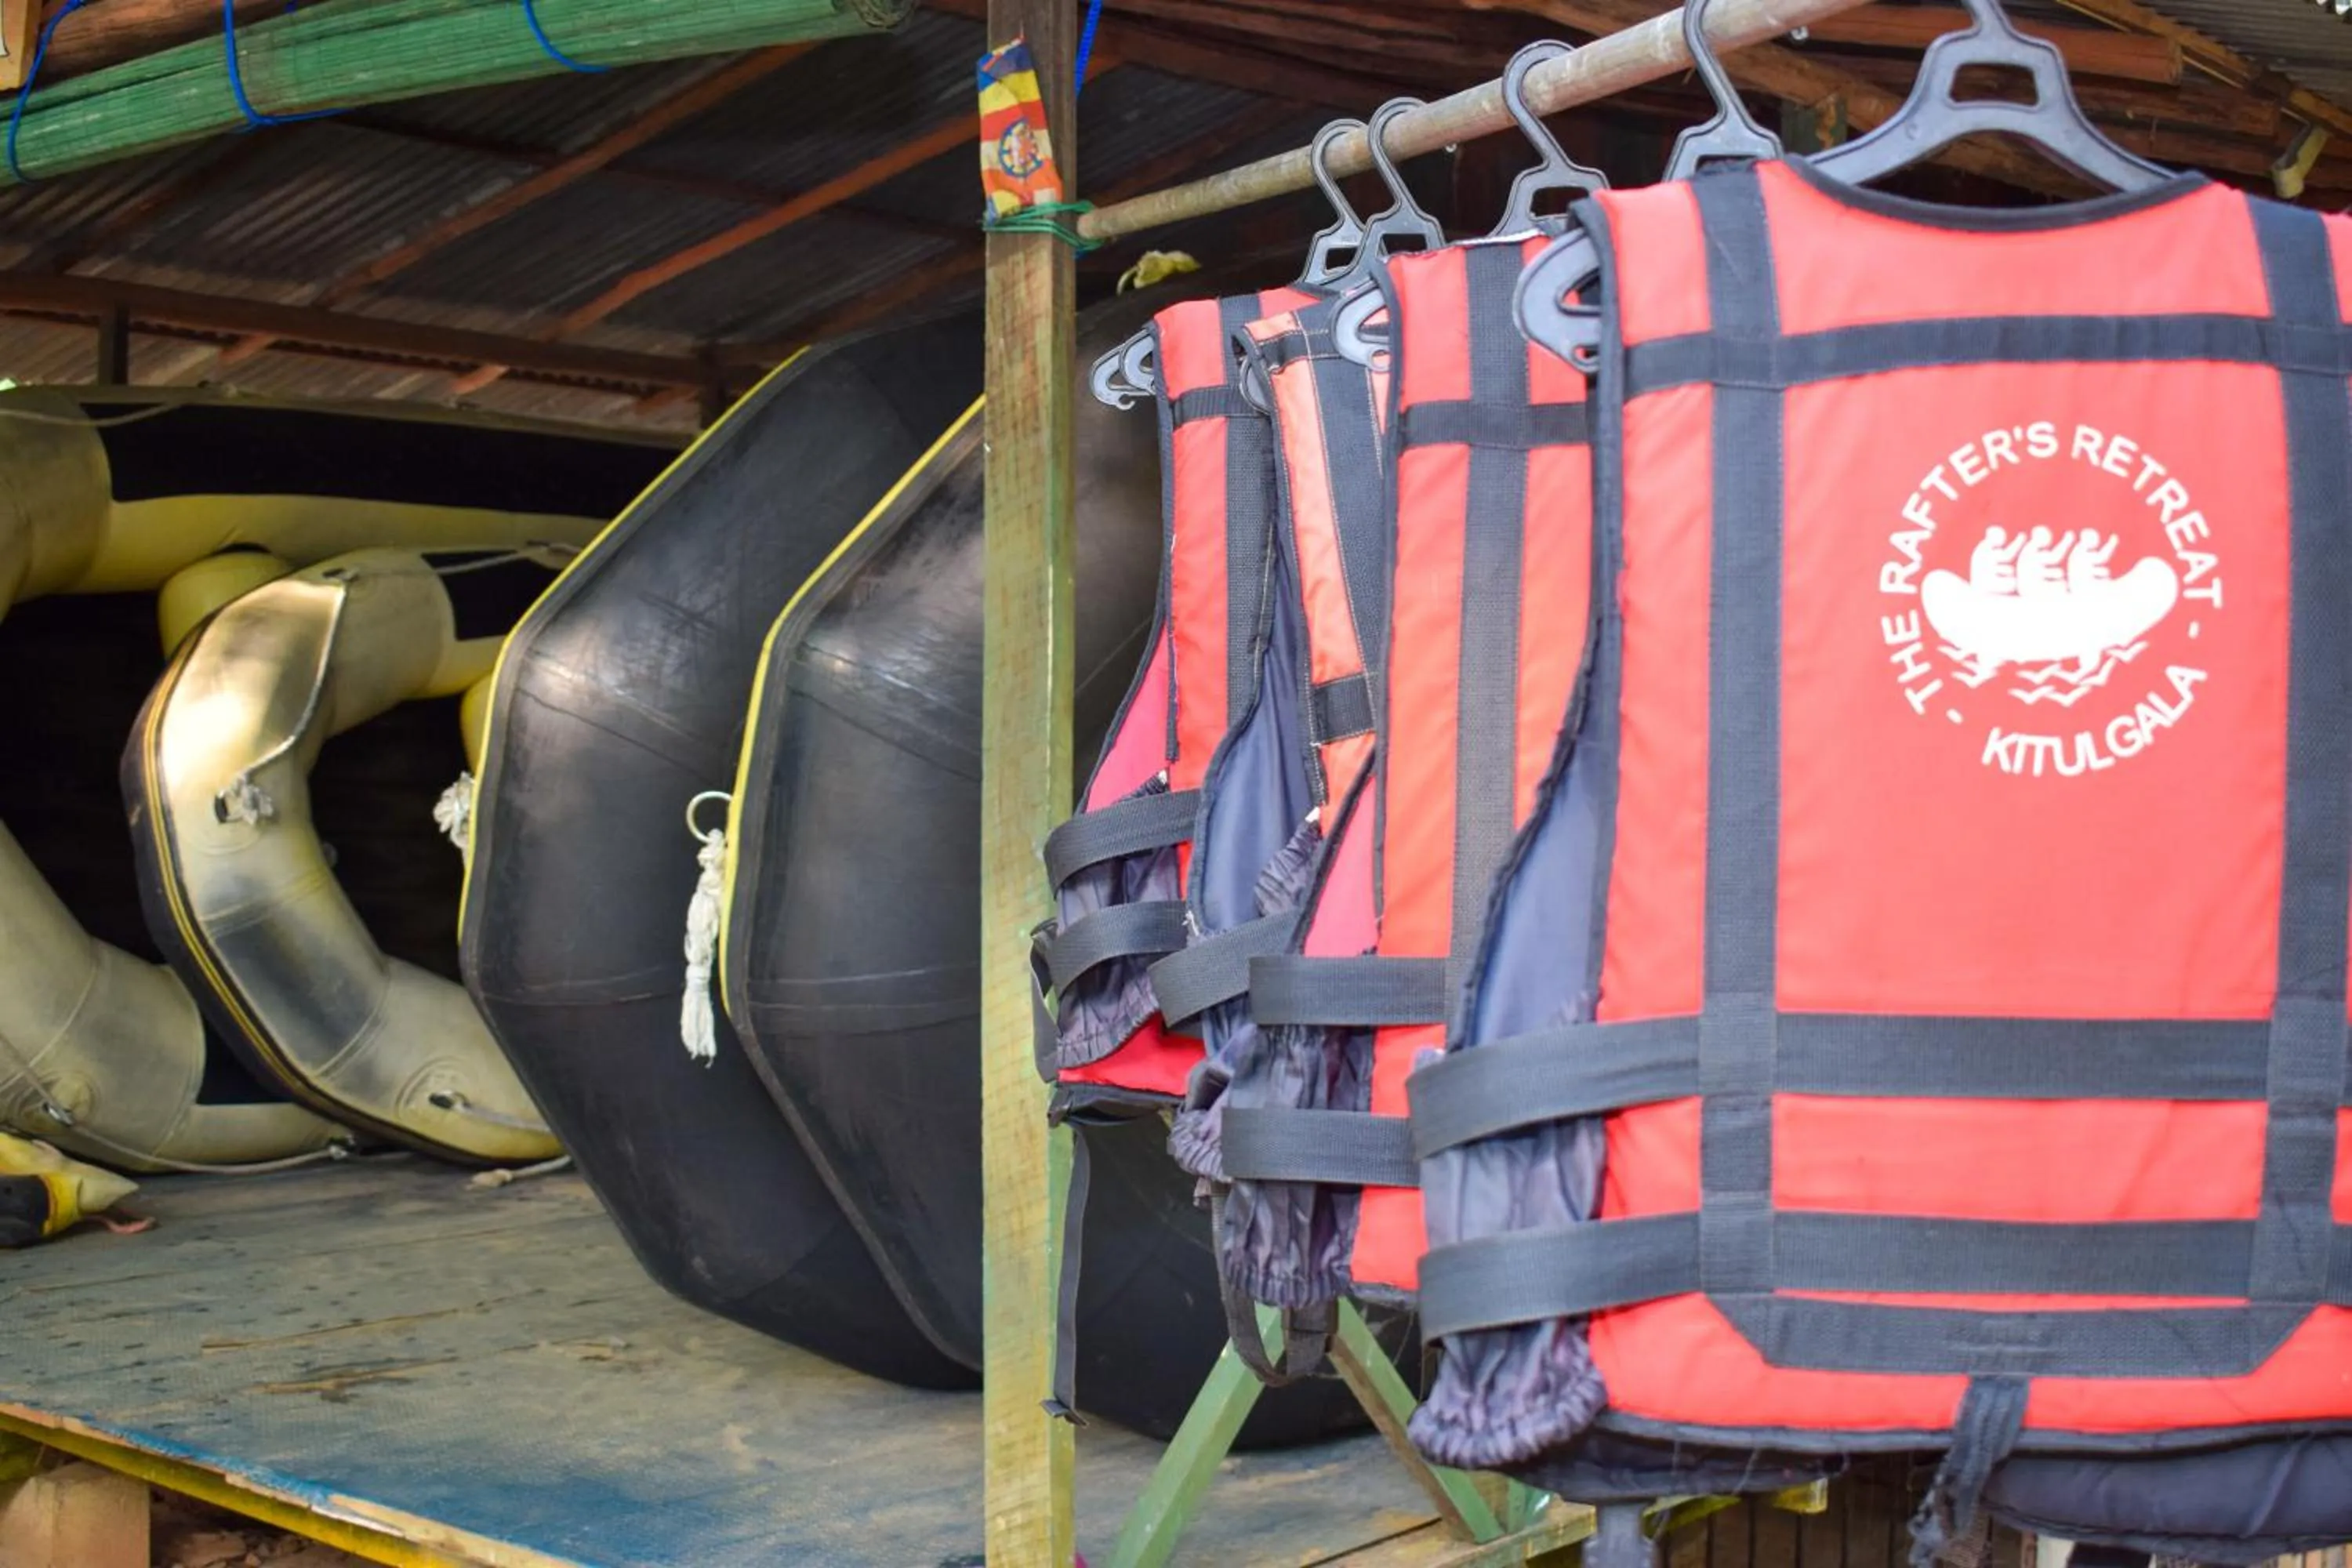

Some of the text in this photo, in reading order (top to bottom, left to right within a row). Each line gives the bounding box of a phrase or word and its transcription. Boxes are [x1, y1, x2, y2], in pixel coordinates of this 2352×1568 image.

[1878, 421, 2223, 715] THE RAFTER'S RETREAT
[1981, 666, 2207, 776] KITULGALA
